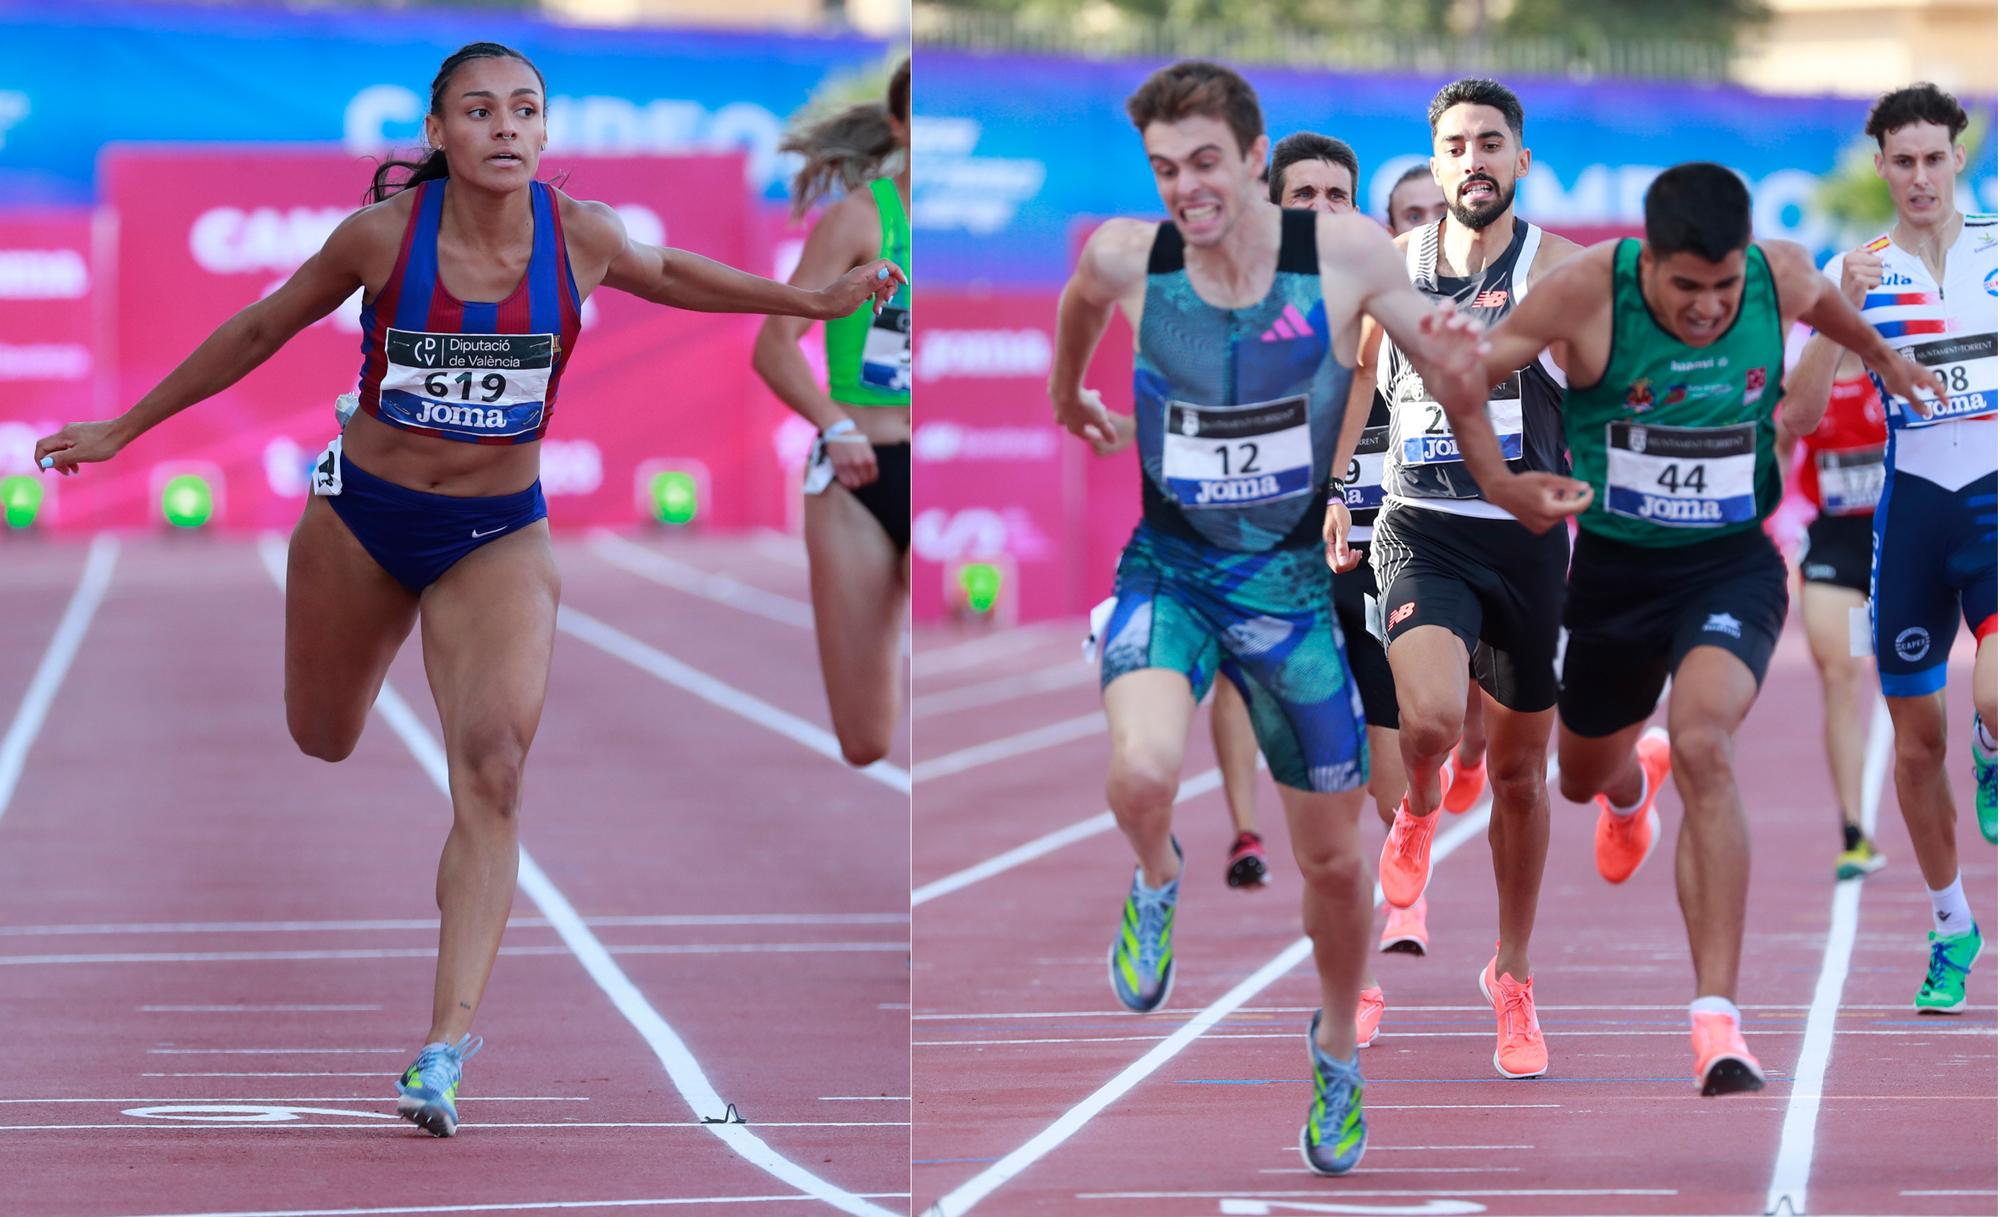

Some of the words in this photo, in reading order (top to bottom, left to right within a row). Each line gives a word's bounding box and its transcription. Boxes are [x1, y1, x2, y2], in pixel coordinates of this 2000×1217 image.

[450, 338, 510, 353] Diputació
[449, 354, 465, 367] de
[469, 354, 521, 367] València
[424, 371, 507, 402] 619
[416, 402, 507, 428] Joma
[1216, 442, 1260, 475] 12
[1196, 475, 1280, 503] Joma
[1657, 464, 1707, 493] 44
[1638, 496, 1722, 520] Joma
